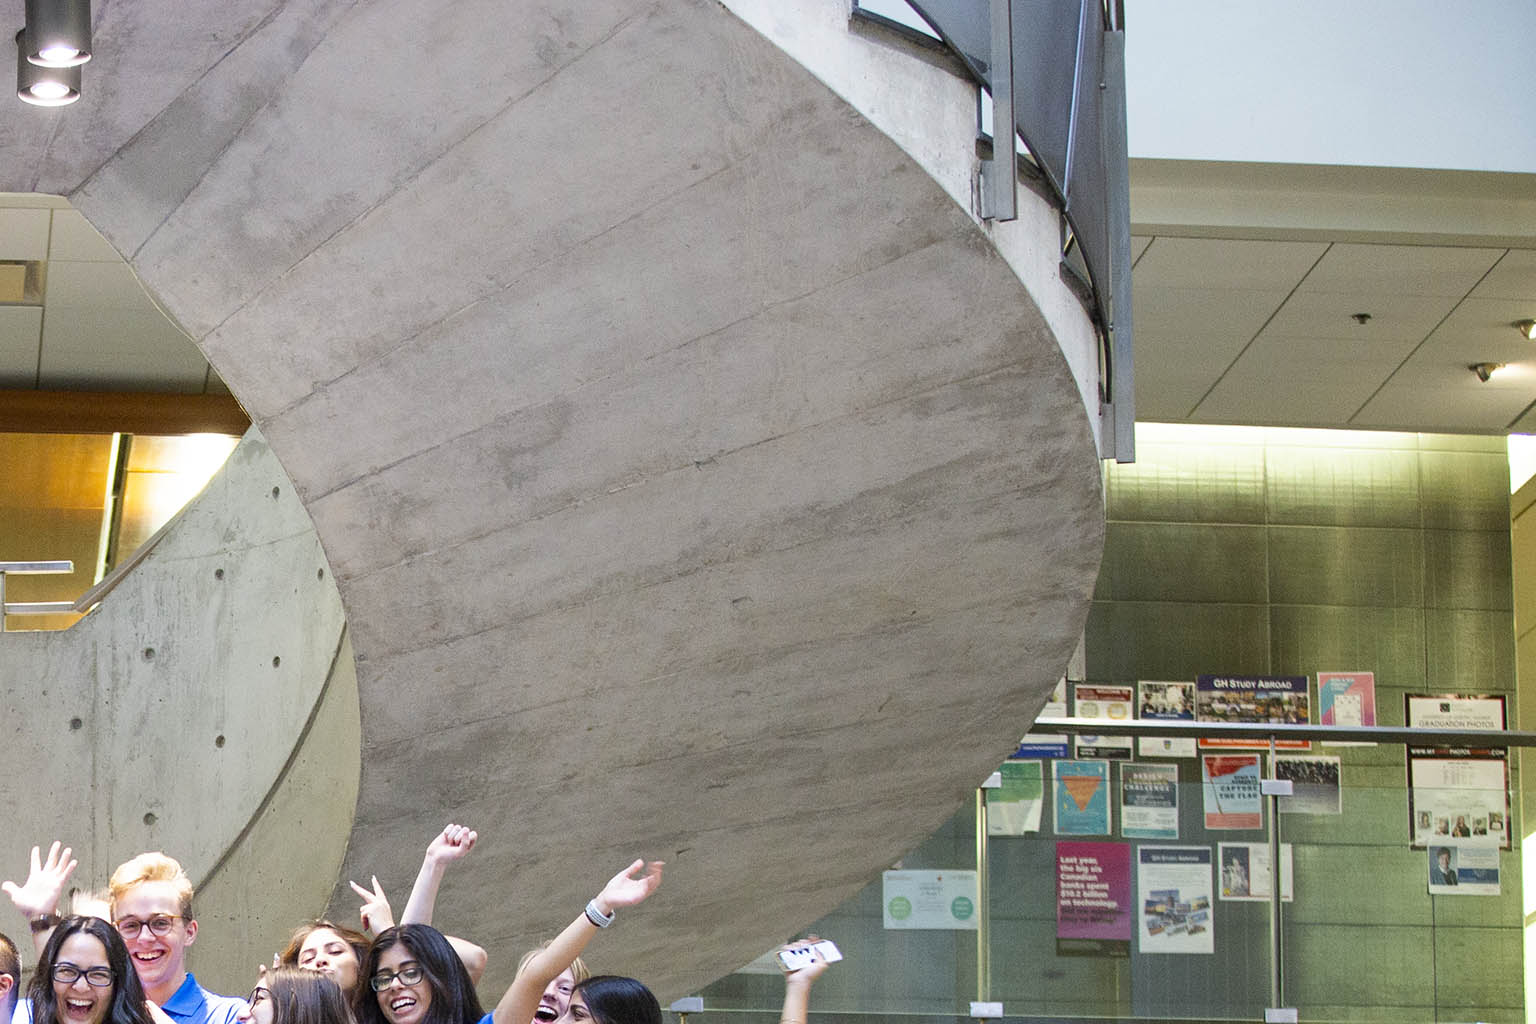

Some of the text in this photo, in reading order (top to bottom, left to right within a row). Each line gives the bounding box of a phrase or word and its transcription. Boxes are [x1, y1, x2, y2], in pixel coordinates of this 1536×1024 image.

[1230, 680, 1256, 689] STUDY
[1258, 680, 1293, 690] ABROAD
[1418, 720, 1465, 728] GRADUATION
[1124, 784, 1170, 792] CHALLENGE
[1060, 856, 1078, 864] Last
[1060, 865, 1075, 873] the
[1076, 865, 1089, 874] big
[1060, 882, 1110, 892] banks spent
[1083, 891, 1109, 899] billion
